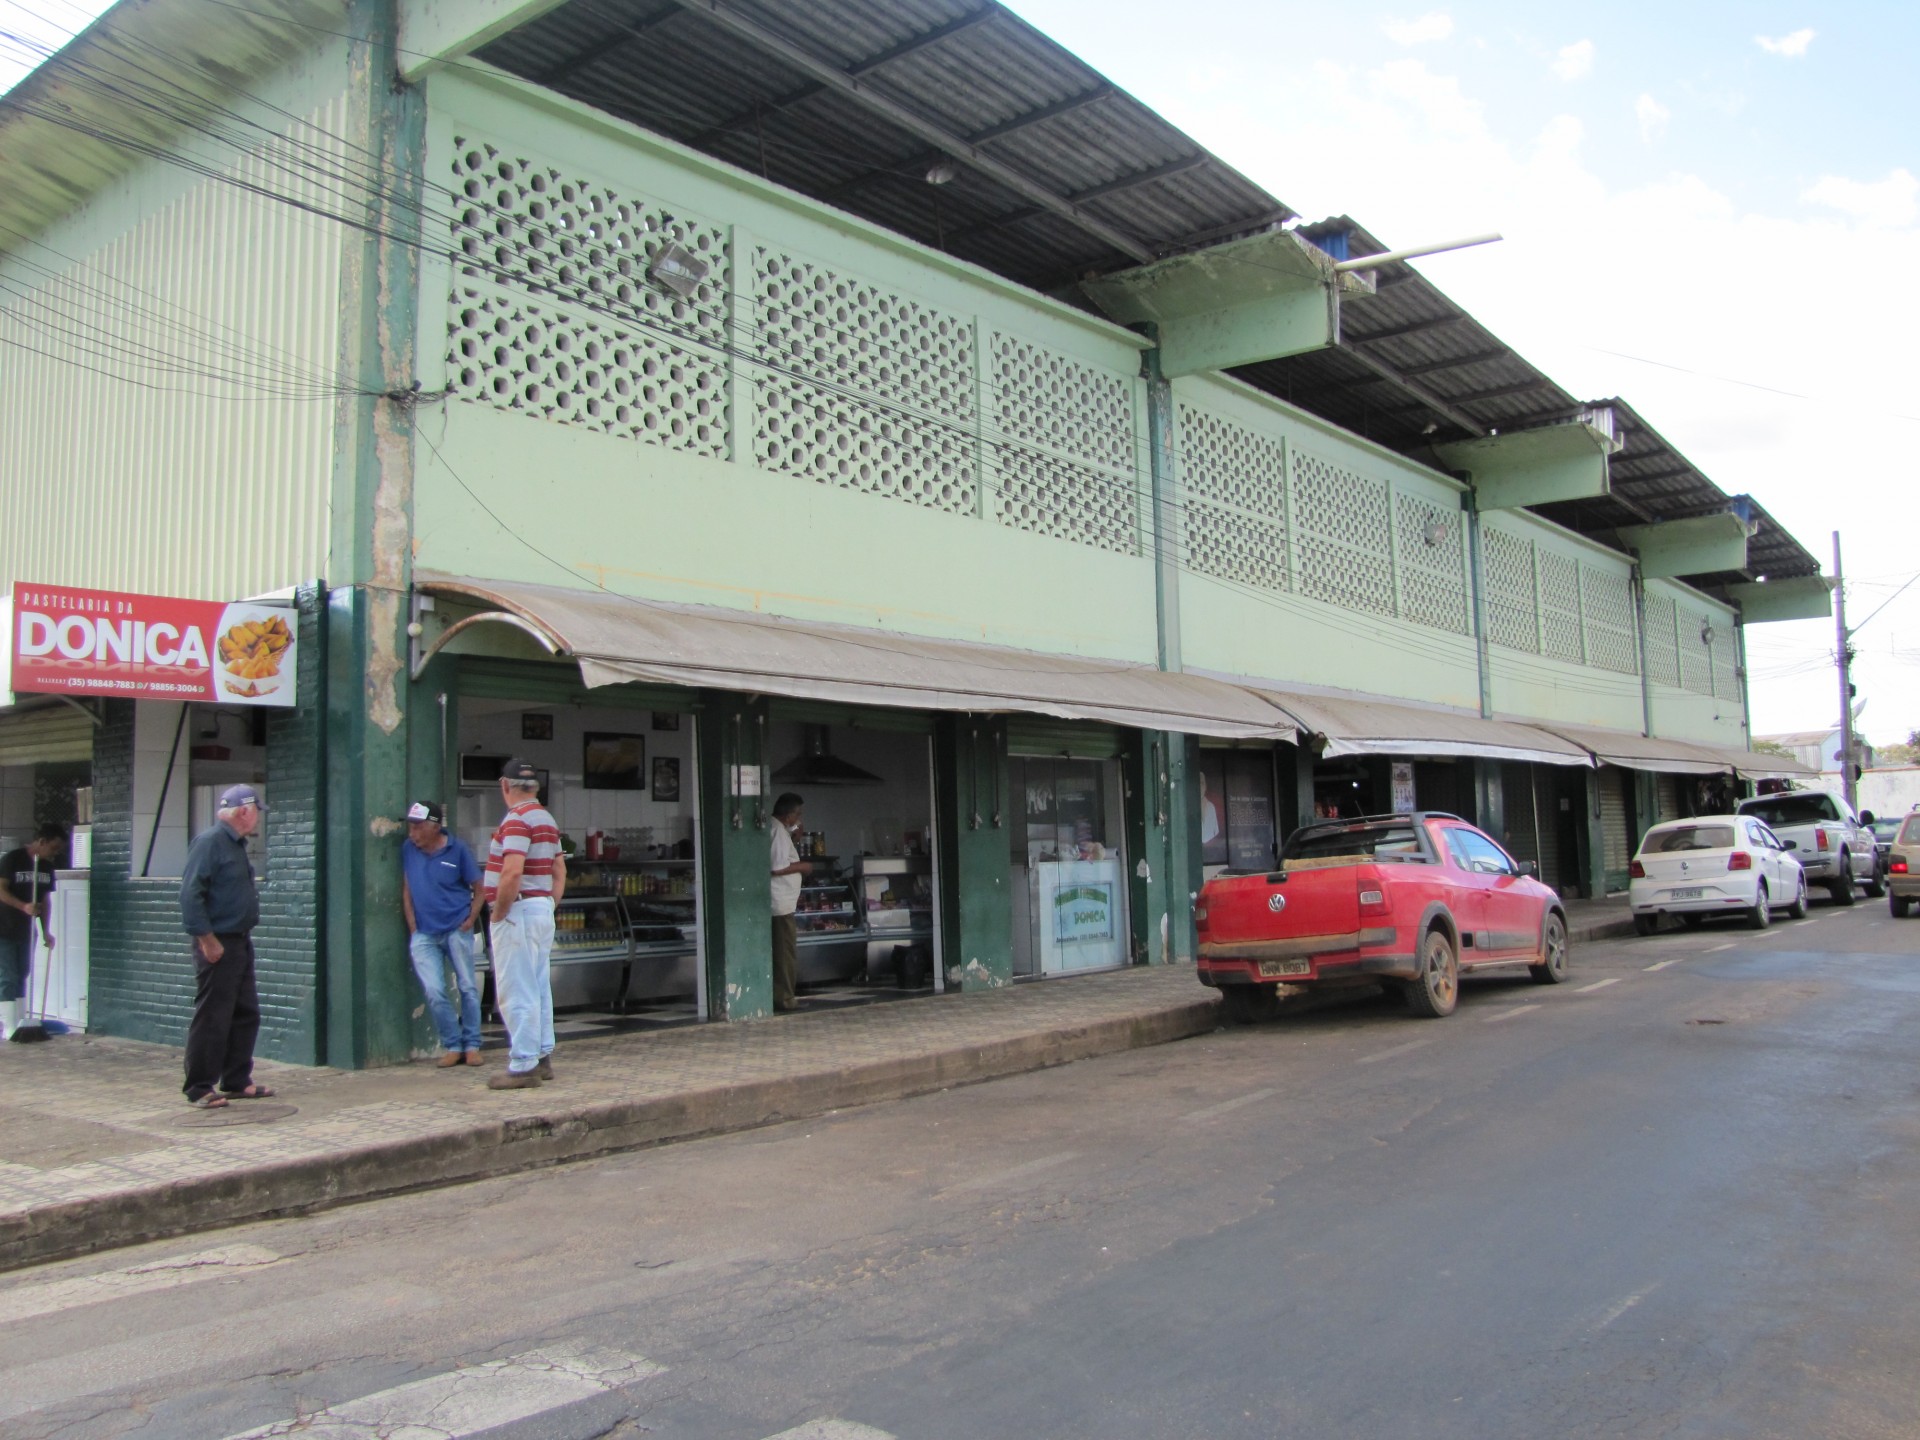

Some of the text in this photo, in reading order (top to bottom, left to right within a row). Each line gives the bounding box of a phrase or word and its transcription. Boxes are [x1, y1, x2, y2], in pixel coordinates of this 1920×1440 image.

[24, 592, 133, 614] PASTELARIA DA
[19, 611, 210, 667] DONICA
[68, 677, 86, 687] (35)
[87, 678, 136, 689] 98848-7883
[150, 682, 198, 692] 98856-3004
[1230, 802, 1269, 826] Rafael
[1073, 909, 1106, 925] DONICA
